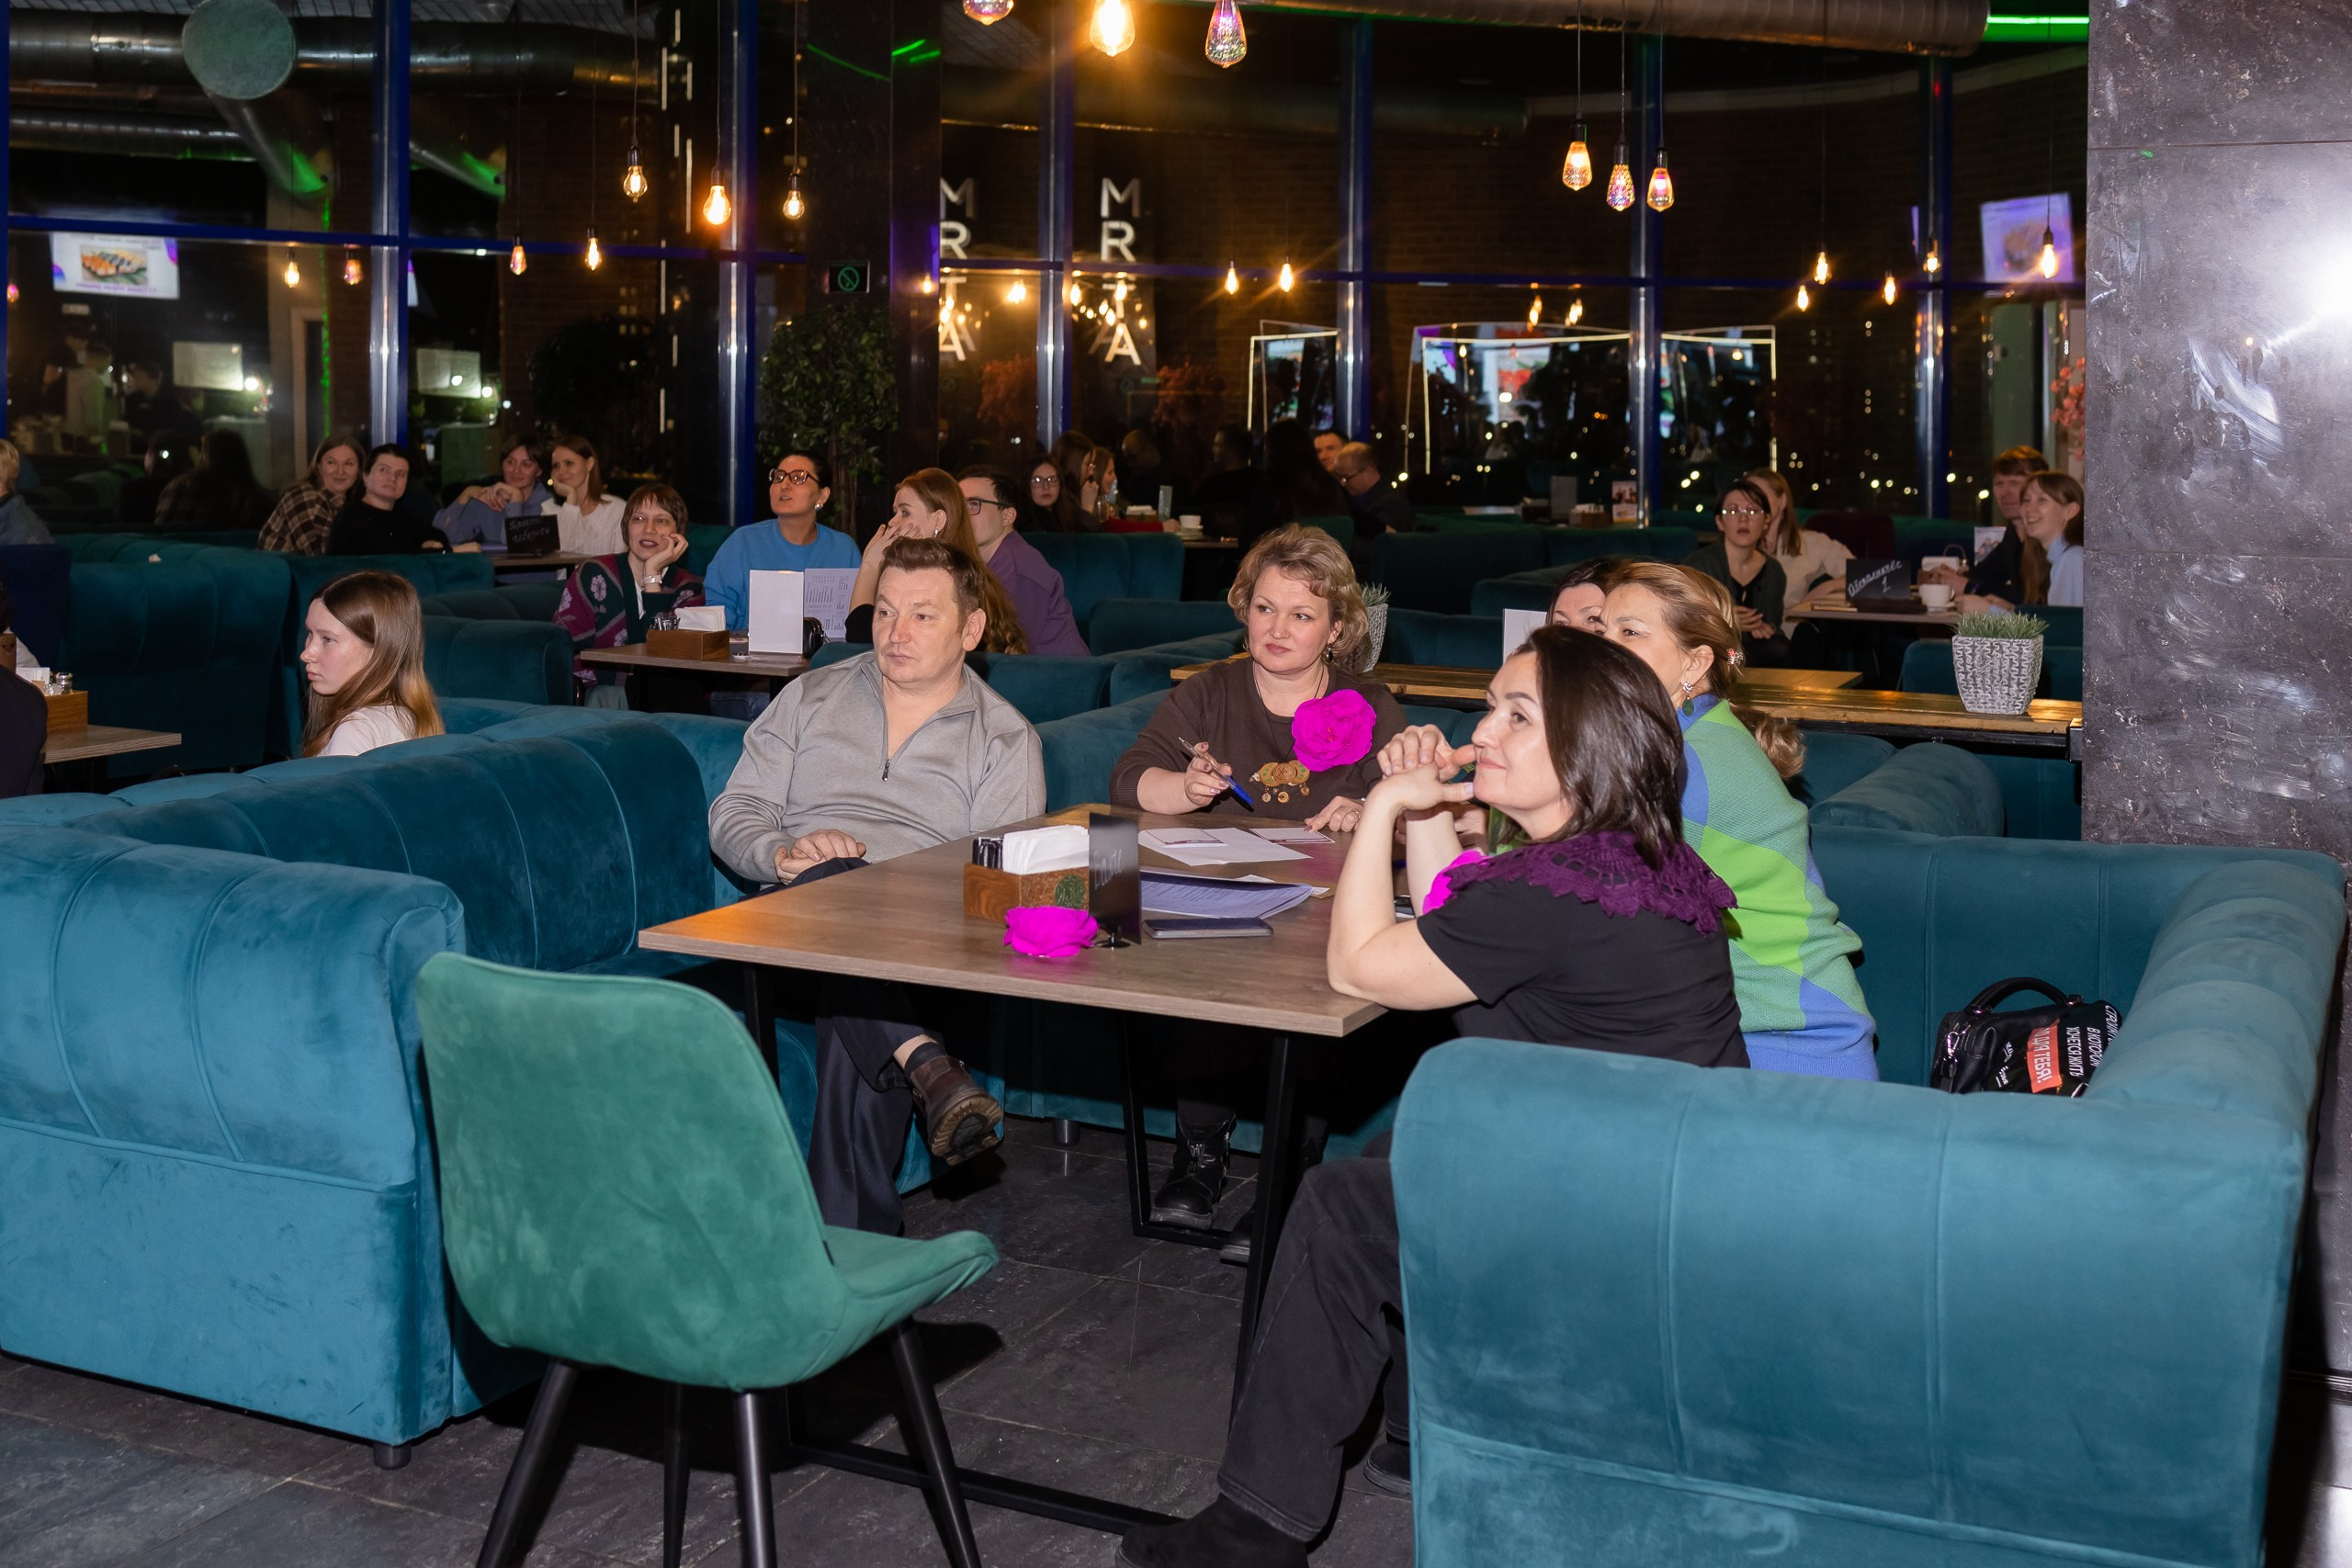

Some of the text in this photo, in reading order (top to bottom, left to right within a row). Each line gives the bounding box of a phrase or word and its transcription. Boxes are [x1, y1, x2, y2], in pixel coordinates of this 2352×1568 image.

[2033, 1052, 2052, 1084] ТЕБЯ!
[2066, 1027, 2084, 1077] ХОЧЕТСЯ ЖИТЬ
